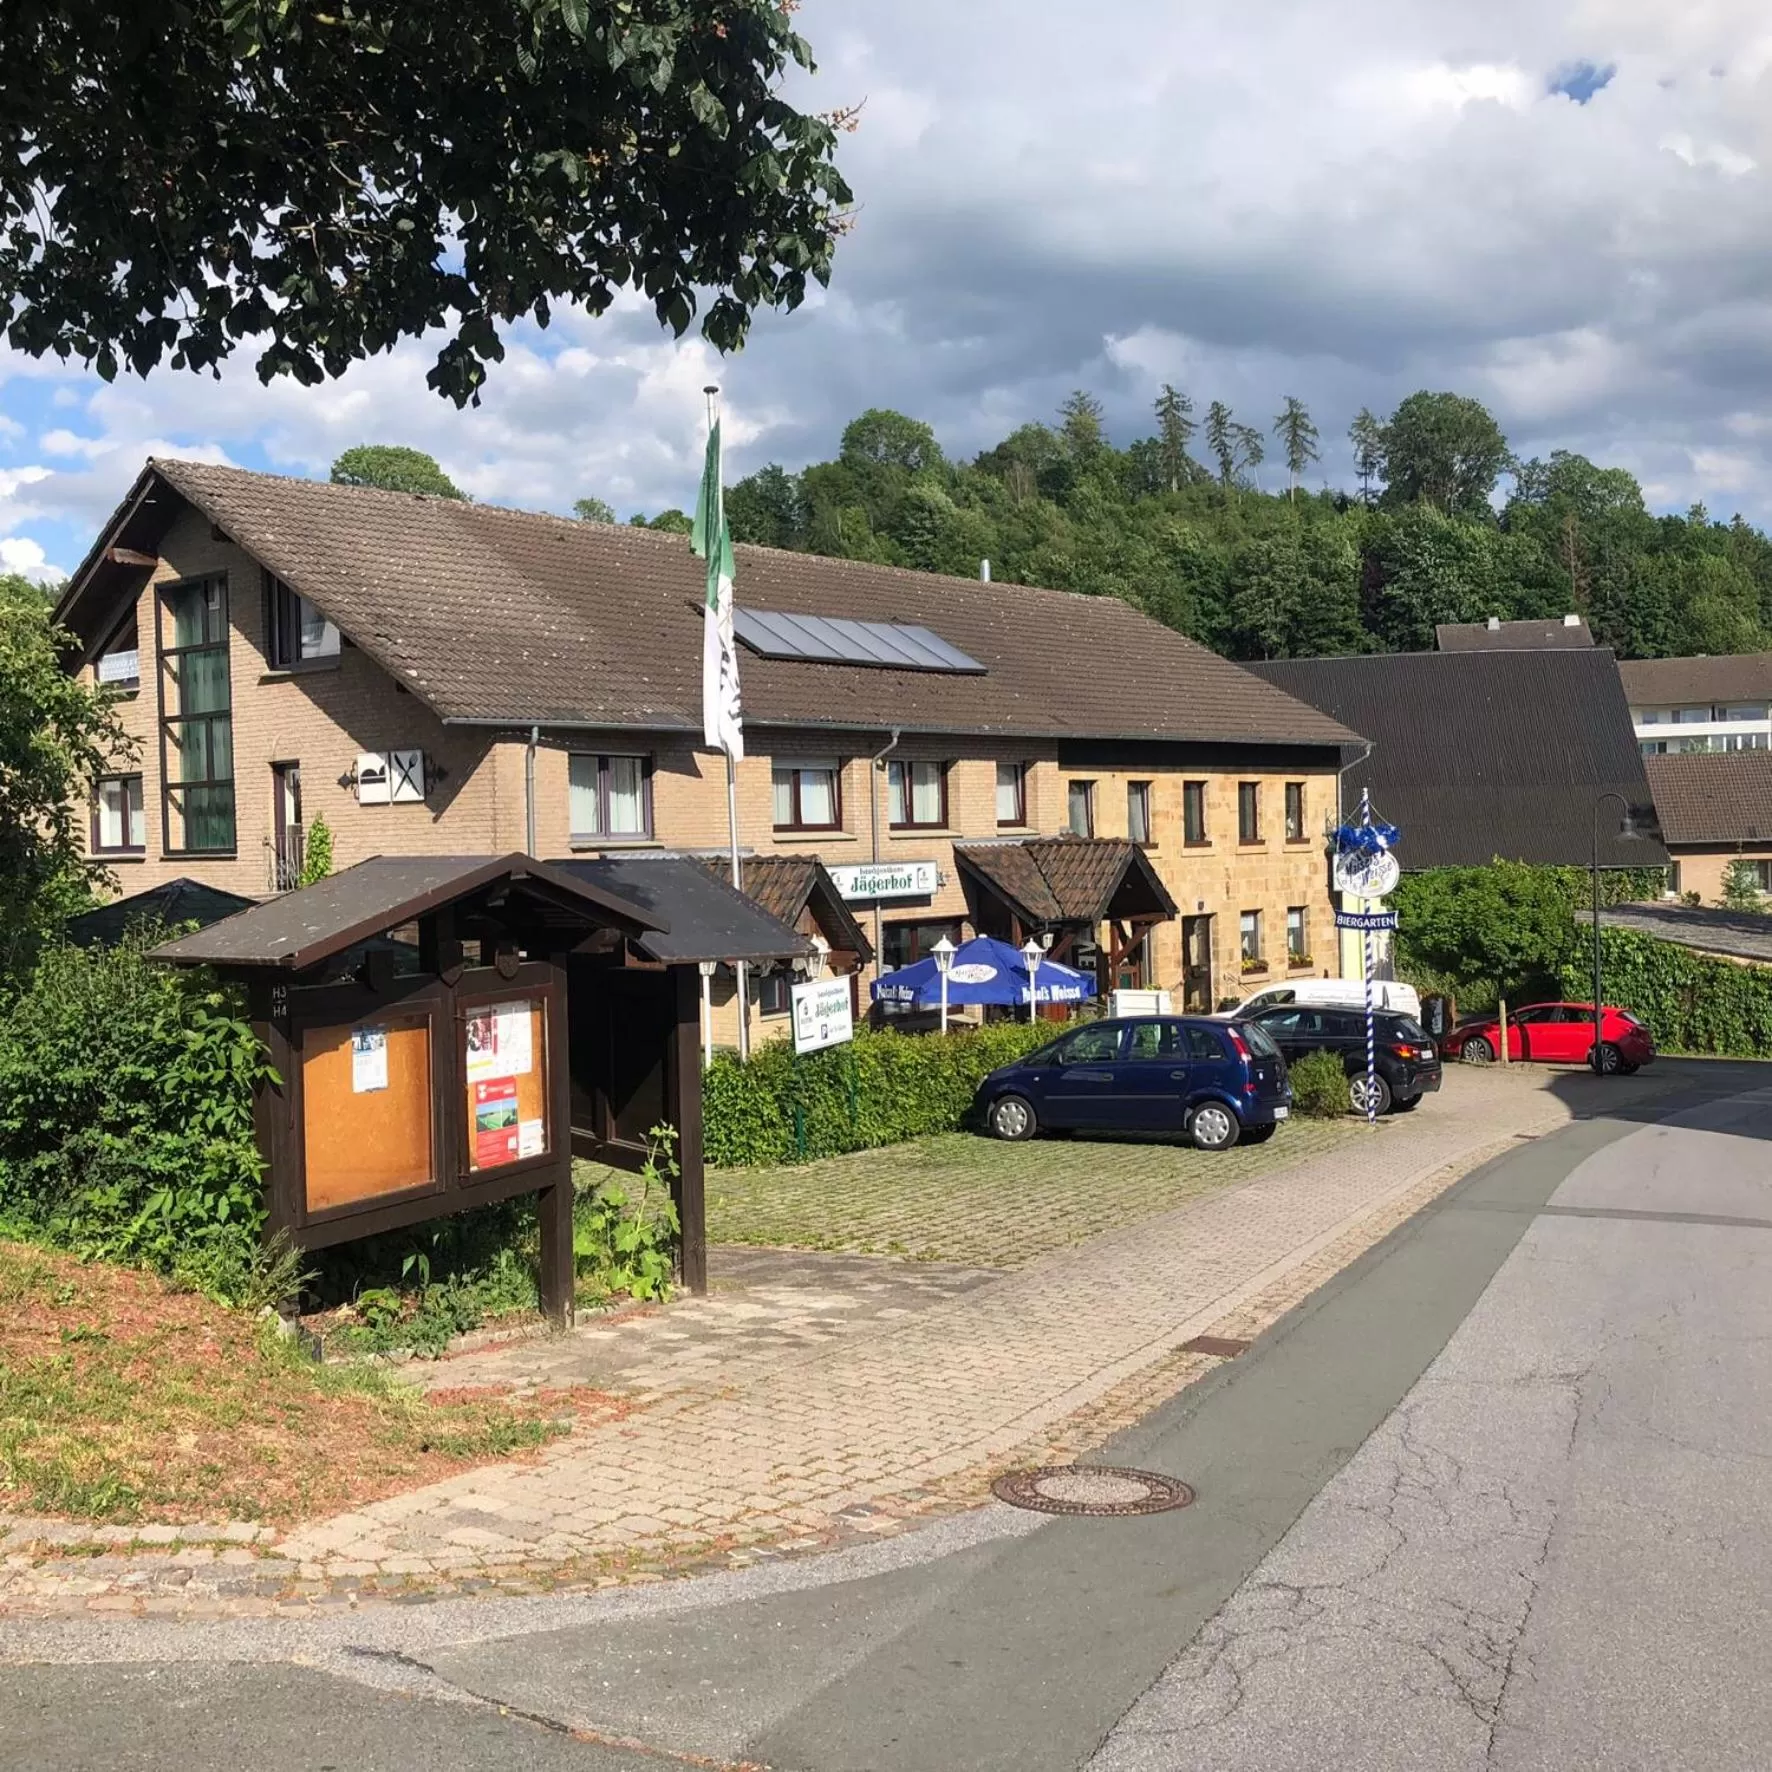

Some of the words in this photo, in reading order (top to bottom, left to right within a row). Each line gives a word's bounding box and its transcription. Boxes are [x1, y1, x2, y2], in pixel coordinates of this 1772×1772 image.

[851, 874, 913, 895] Jägerhof
[1336, 915, 1394, 928] BIERGARTEN
[272, 985, 287, 999] H3
